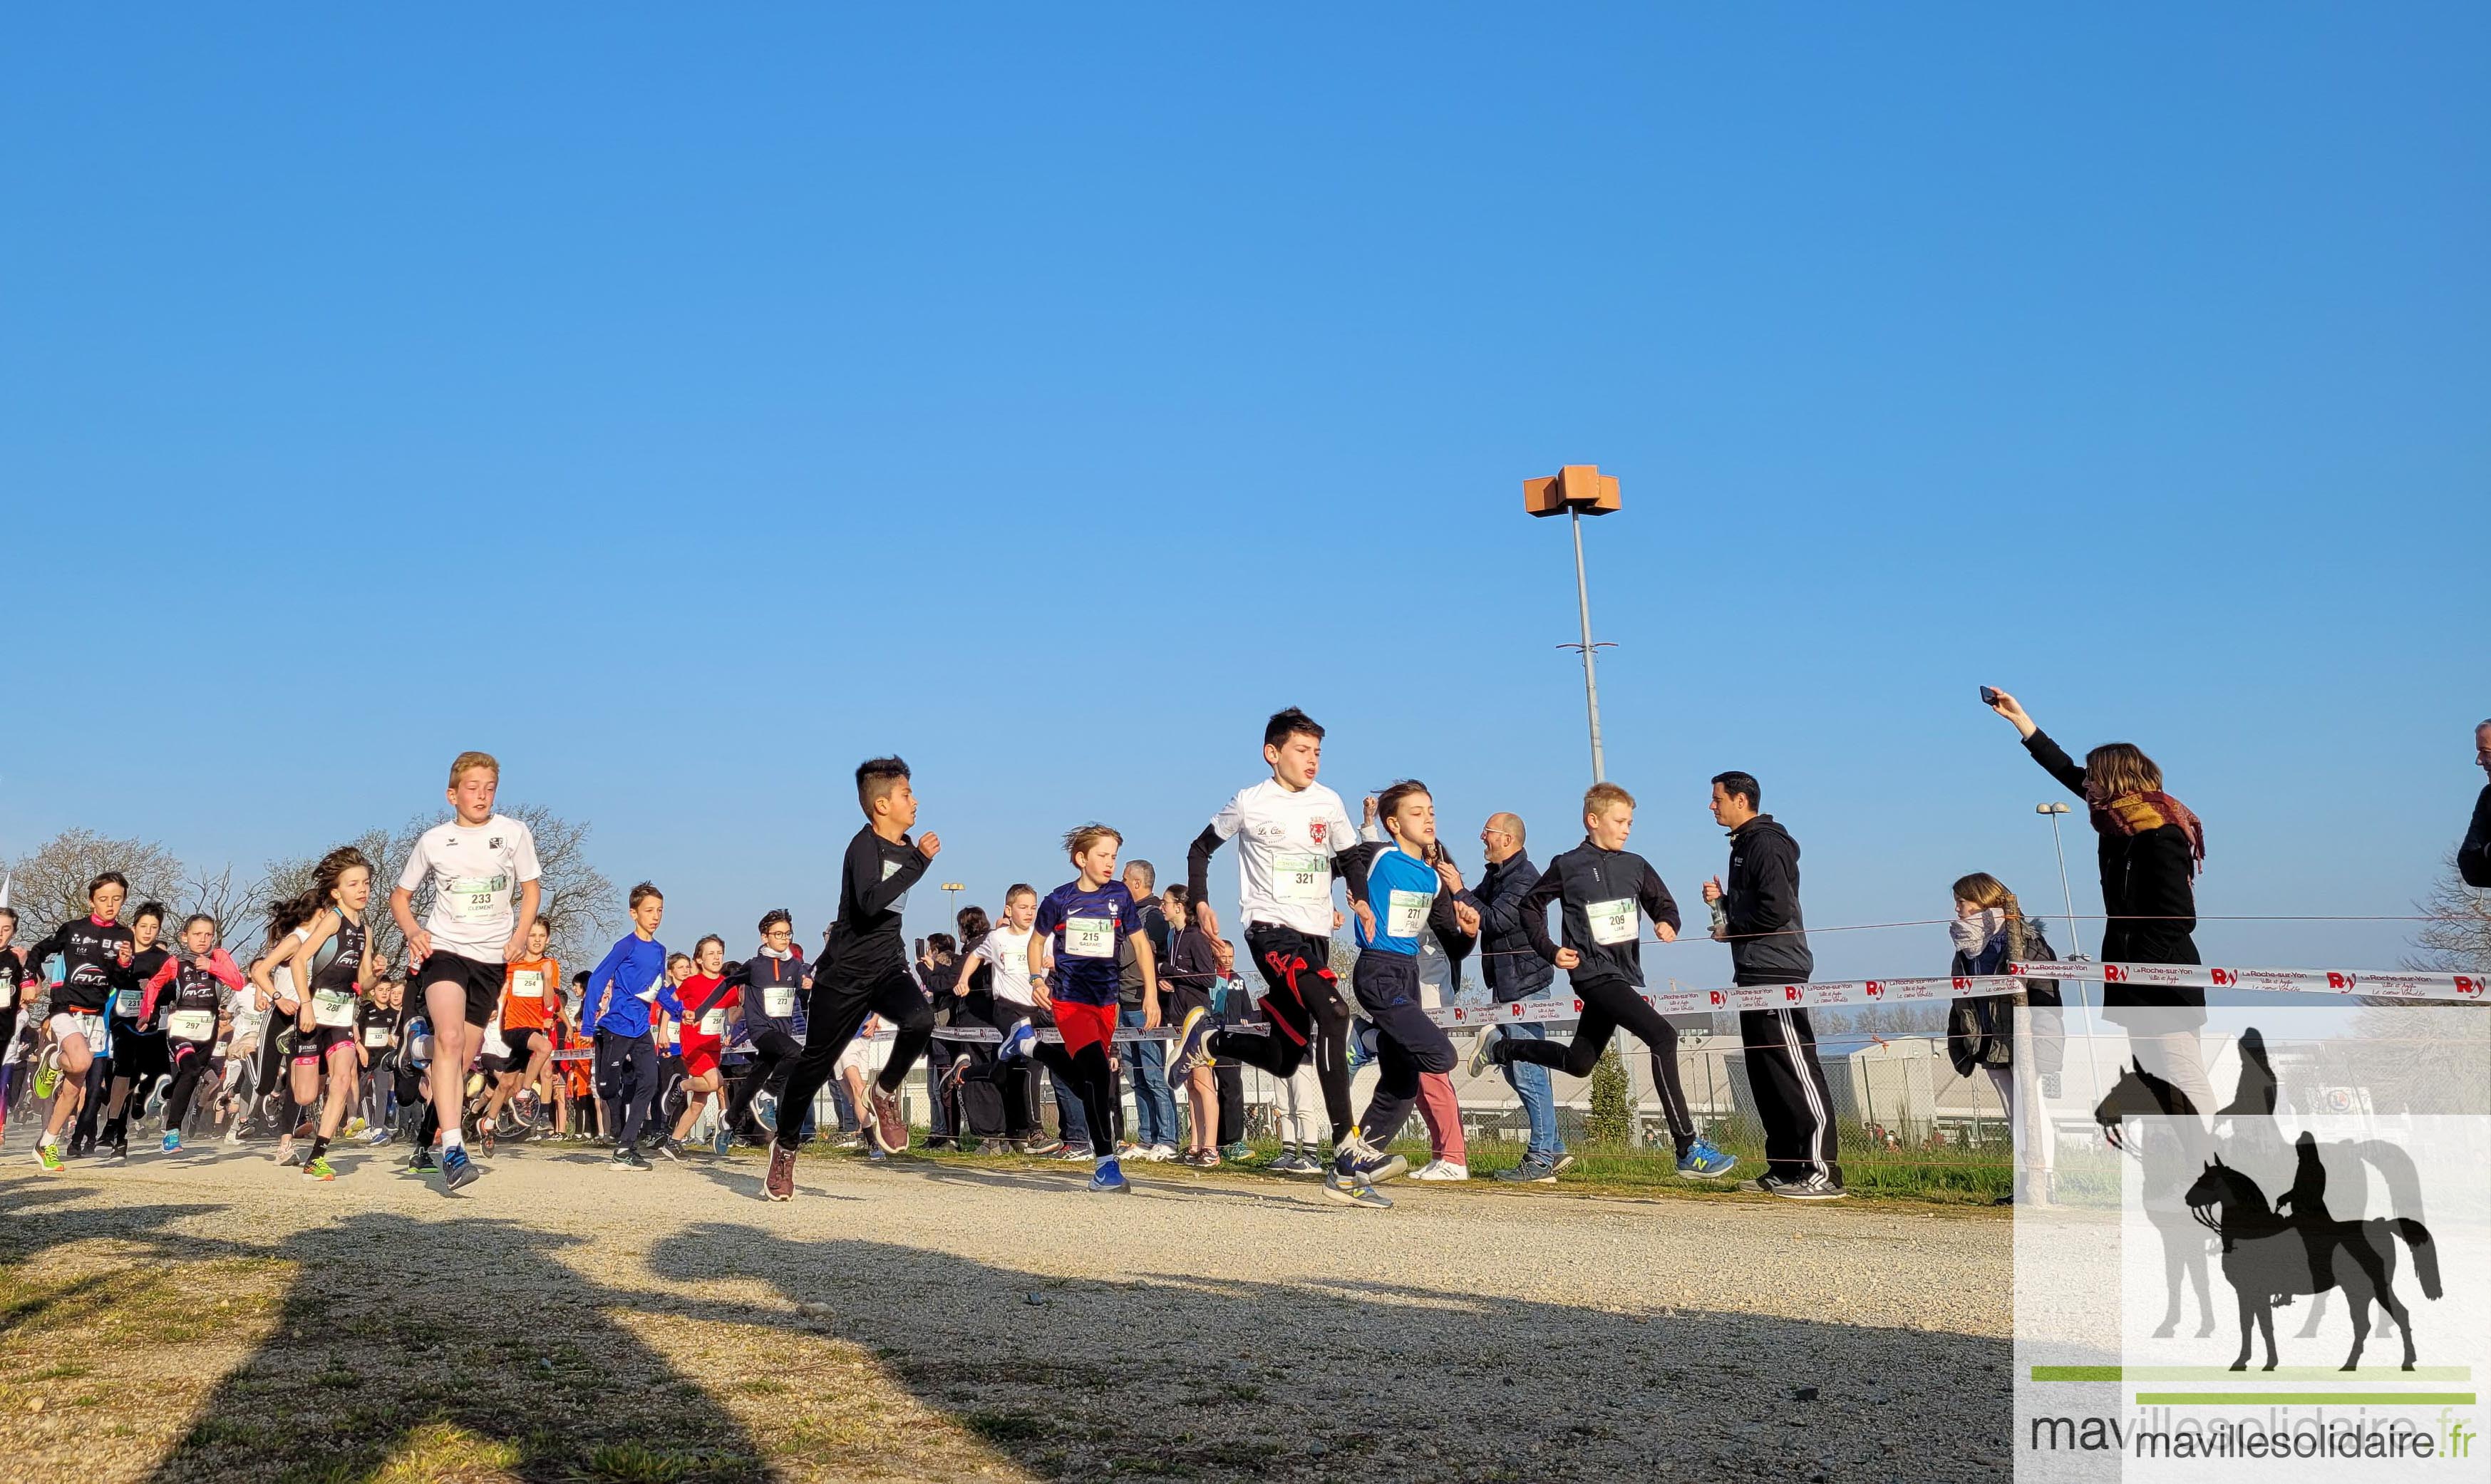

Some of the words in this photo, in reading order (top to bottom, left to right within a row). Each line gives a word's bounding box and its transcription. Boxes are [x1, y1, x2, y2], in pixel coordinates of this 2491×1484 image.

[1296, 873, 1314, 885] 321
[472, 894, 491, 905] 233
[1407, 908, 1420, 919] 271
[1609, 915, 1625, 926] 209
[1083, 932, 1100, 942] 215
[185, 1021, 200, 1030] 297
